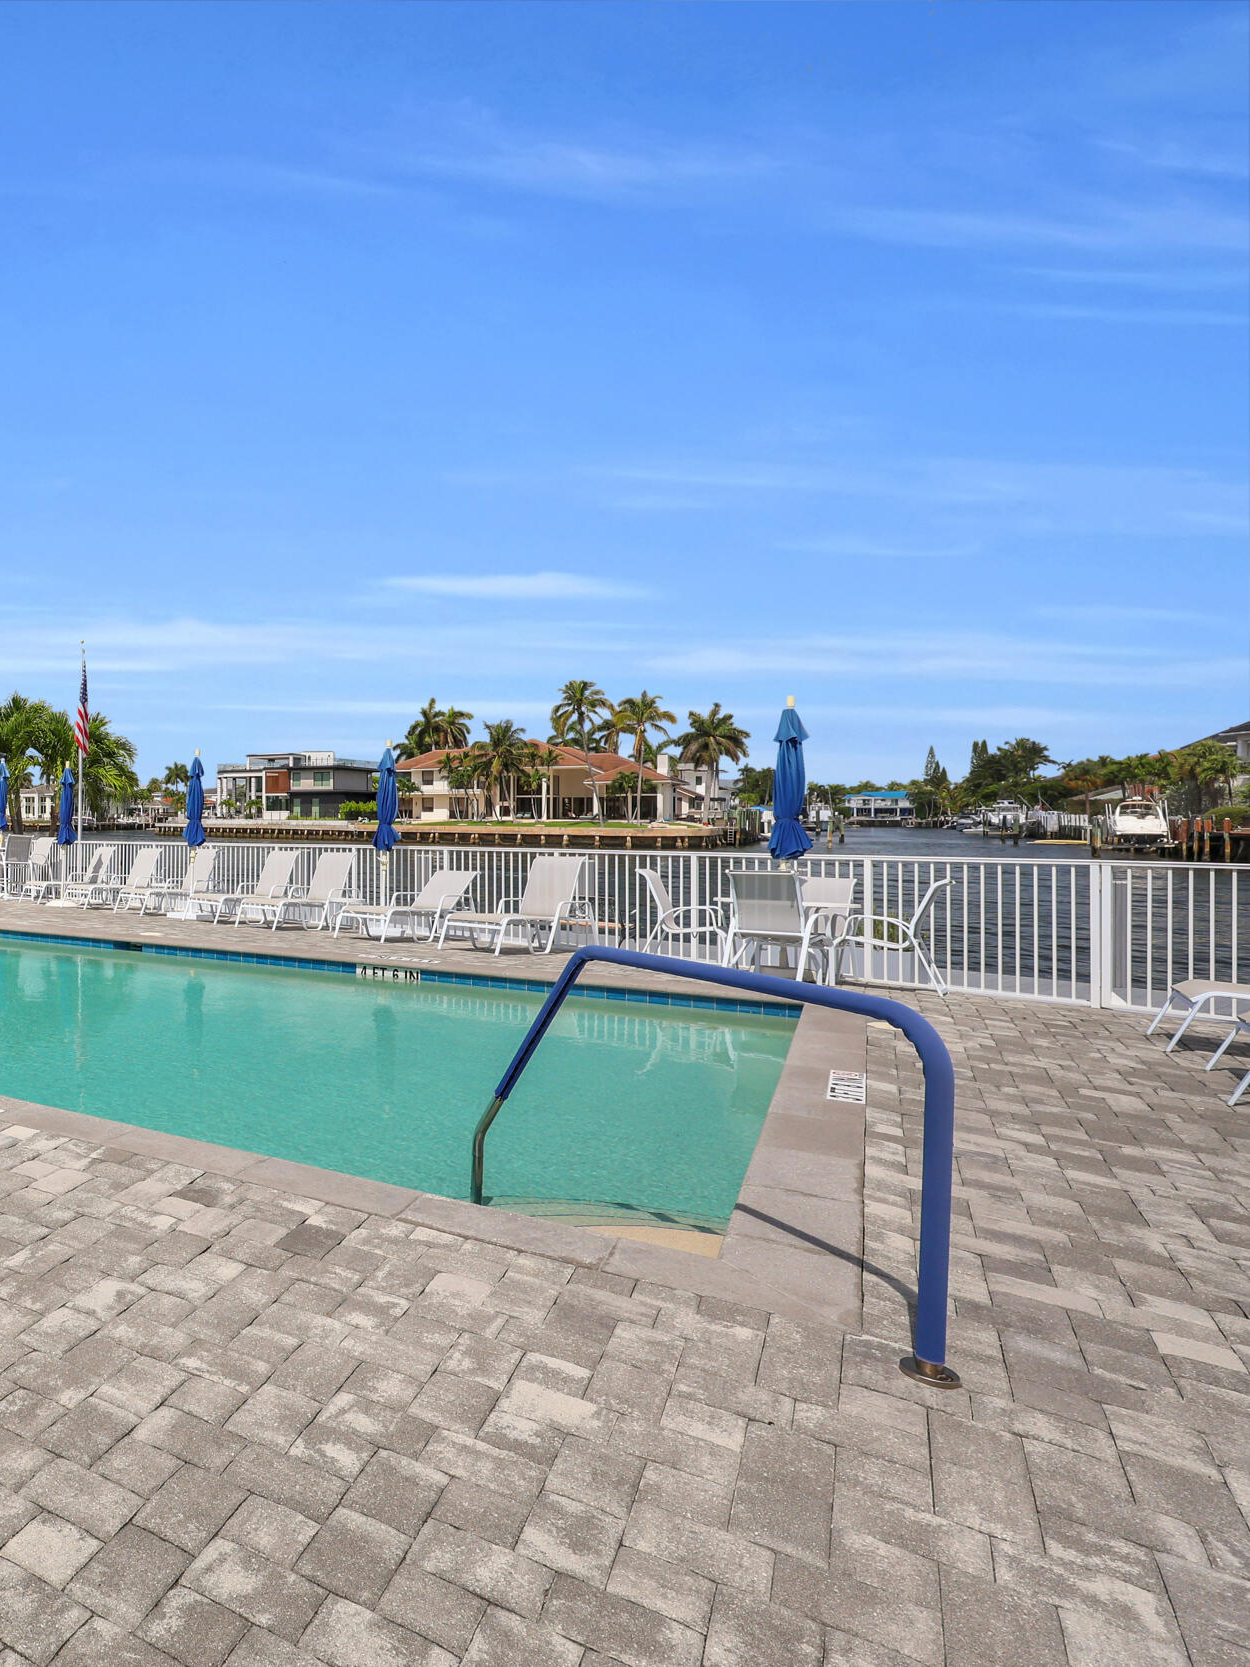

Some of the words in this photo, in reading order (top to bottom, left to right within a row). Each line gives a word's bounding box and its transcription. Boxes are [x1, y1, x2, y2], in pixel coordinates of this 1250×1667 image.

[373, 966, 387, 977] FT
[392, 969, 399, 979] 6
[405, 970, 419, 981] IN
